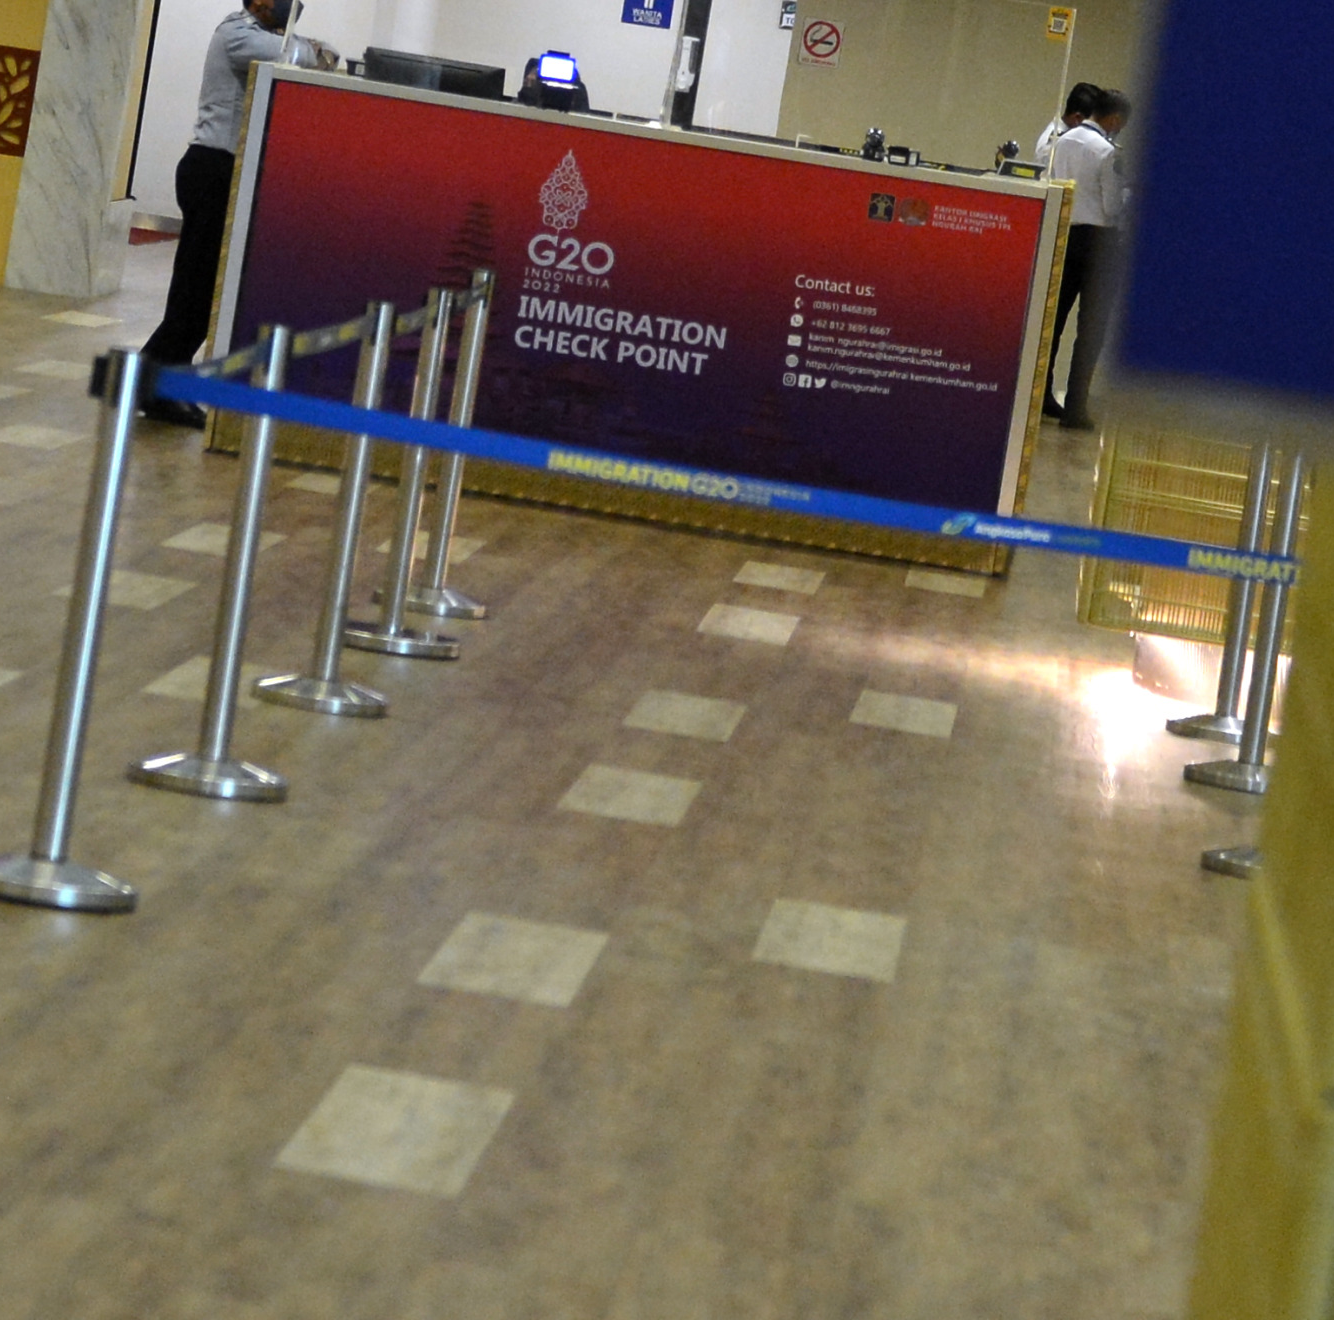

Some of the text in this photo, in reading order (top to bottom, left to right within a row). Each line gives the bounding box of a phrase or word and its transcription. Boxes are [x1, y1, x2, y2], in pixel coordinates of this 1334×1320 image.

[528, 234, 615, 275] G20
[523, 279, 560, 293] 2022
[524, 267, 610, 289] INDONESIA
[795, 274, 875, 297] Contact us:
[813, 300, 839, 313] (0361)
[518, 295, 727, 350] IMMIGRATION
[829, 320, 845, 331] 812
[515, 326, 708, 375] CHECK POINT
[547, 449, 691, 491] IMMIGRATION
[691, 473, 739, 500] G20
